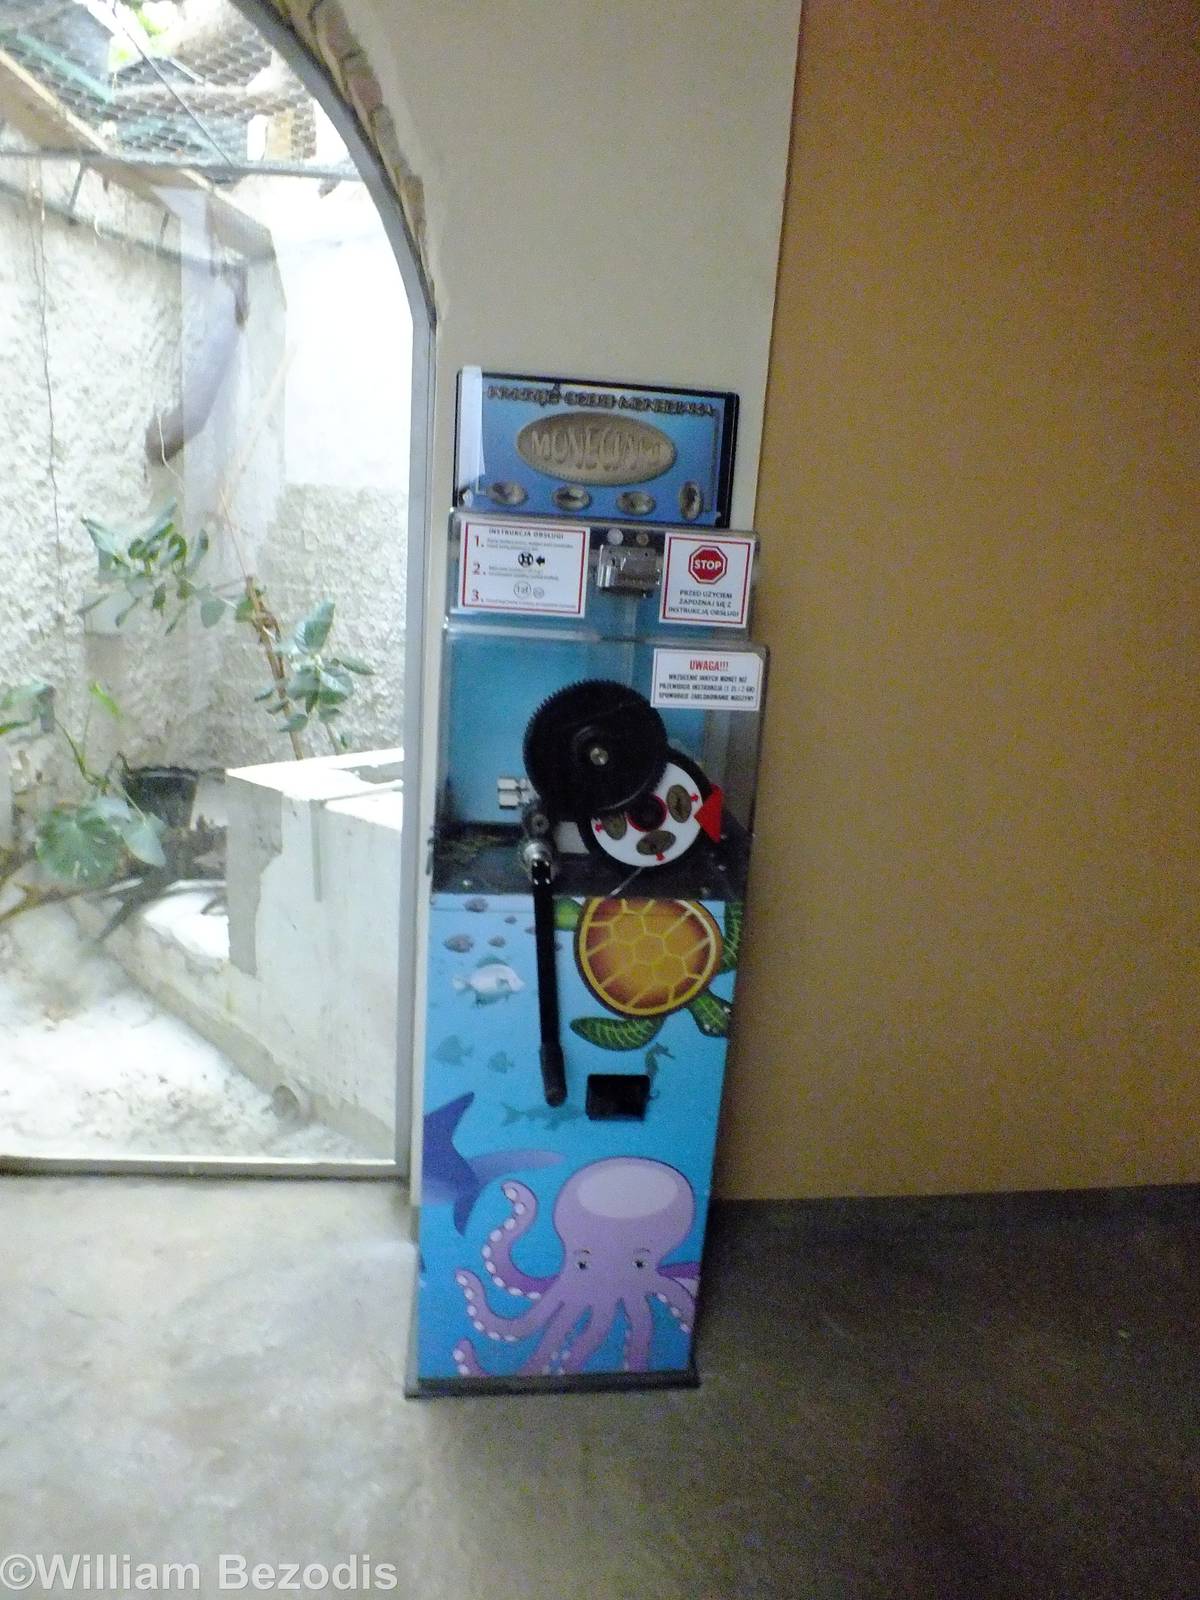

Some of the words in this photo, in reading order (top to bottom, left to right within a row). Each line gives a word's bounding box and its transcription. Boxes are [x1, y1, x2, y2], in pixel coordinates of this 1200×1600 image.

[693, 559, 722, 571] STOP
[679, 598, 715, 606] ZAPOZNAJ
[689, 660, 729, 672] UWAGA!!!
